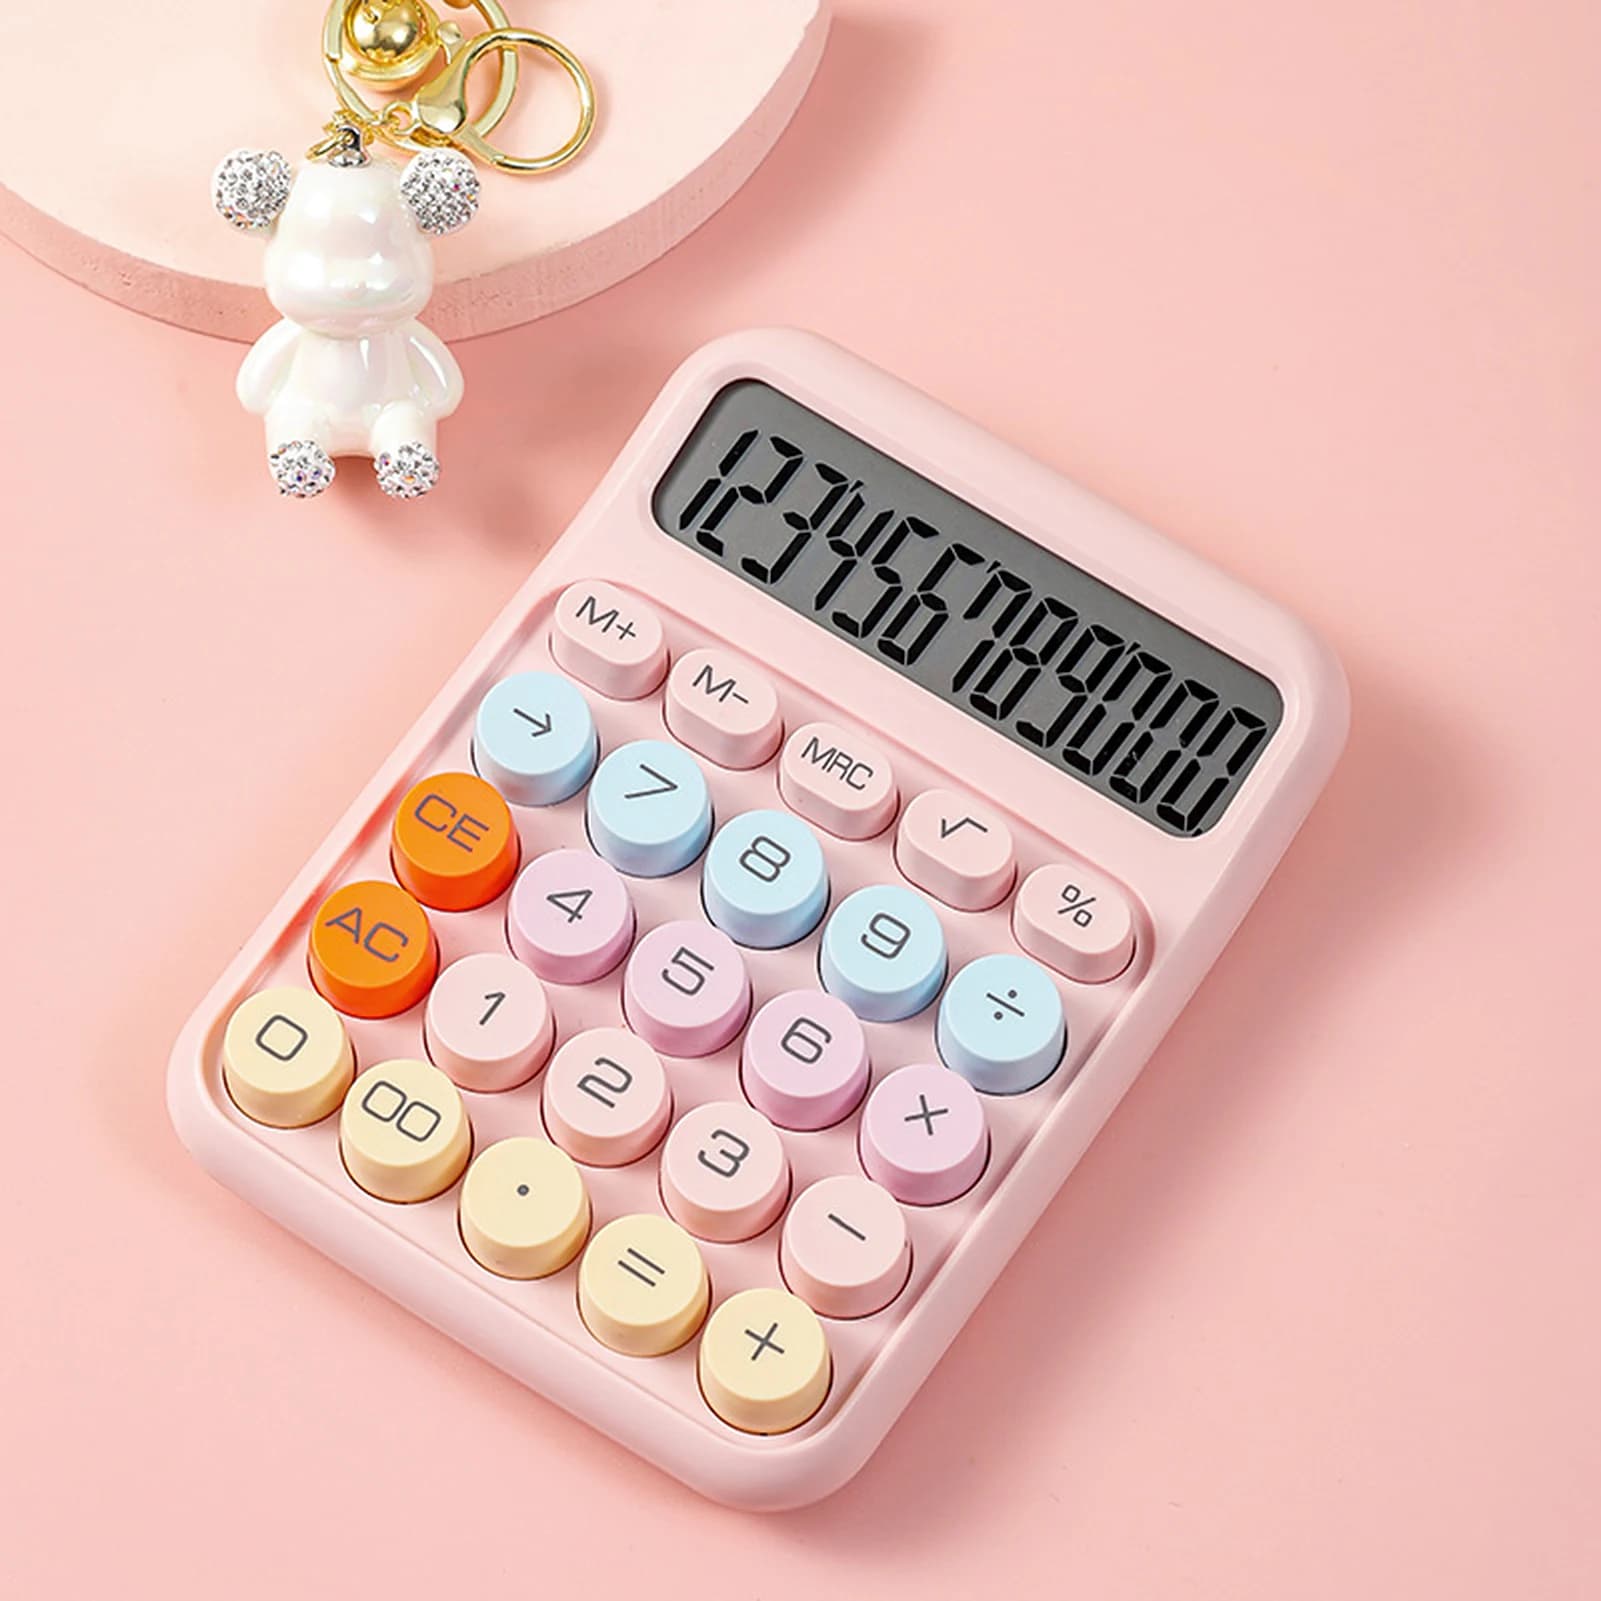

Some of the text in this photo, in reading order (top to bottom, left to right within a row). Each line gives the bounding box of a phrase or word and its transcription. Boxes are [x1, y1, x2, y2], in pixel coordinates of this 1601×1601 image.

[575, 596, 636, 640] M+
[692, 664, 749, 704] M-
[624, 763, 679, 800] 7
[801, 737, 874, 791] MRC
[415, 794, 489, 851] CE
[739, 836, 791, 883] 8
[546, 889, 593, 923] 4
[1057, 884, 1097, 928] %
[326, 908, 408, 962] AC
[860, 913, 911, 960] 9
[662, 946, 715, 996] 5
[479, 992, 506, 1026] 1
[255, 1015, 308, 1061] 0
[781, 1017, 832, 1064] 6
[577, 1057, 633, 1108] 2
[360, 1077, 442, 1143] 00
[698, 1129, 750, 1178] 3
